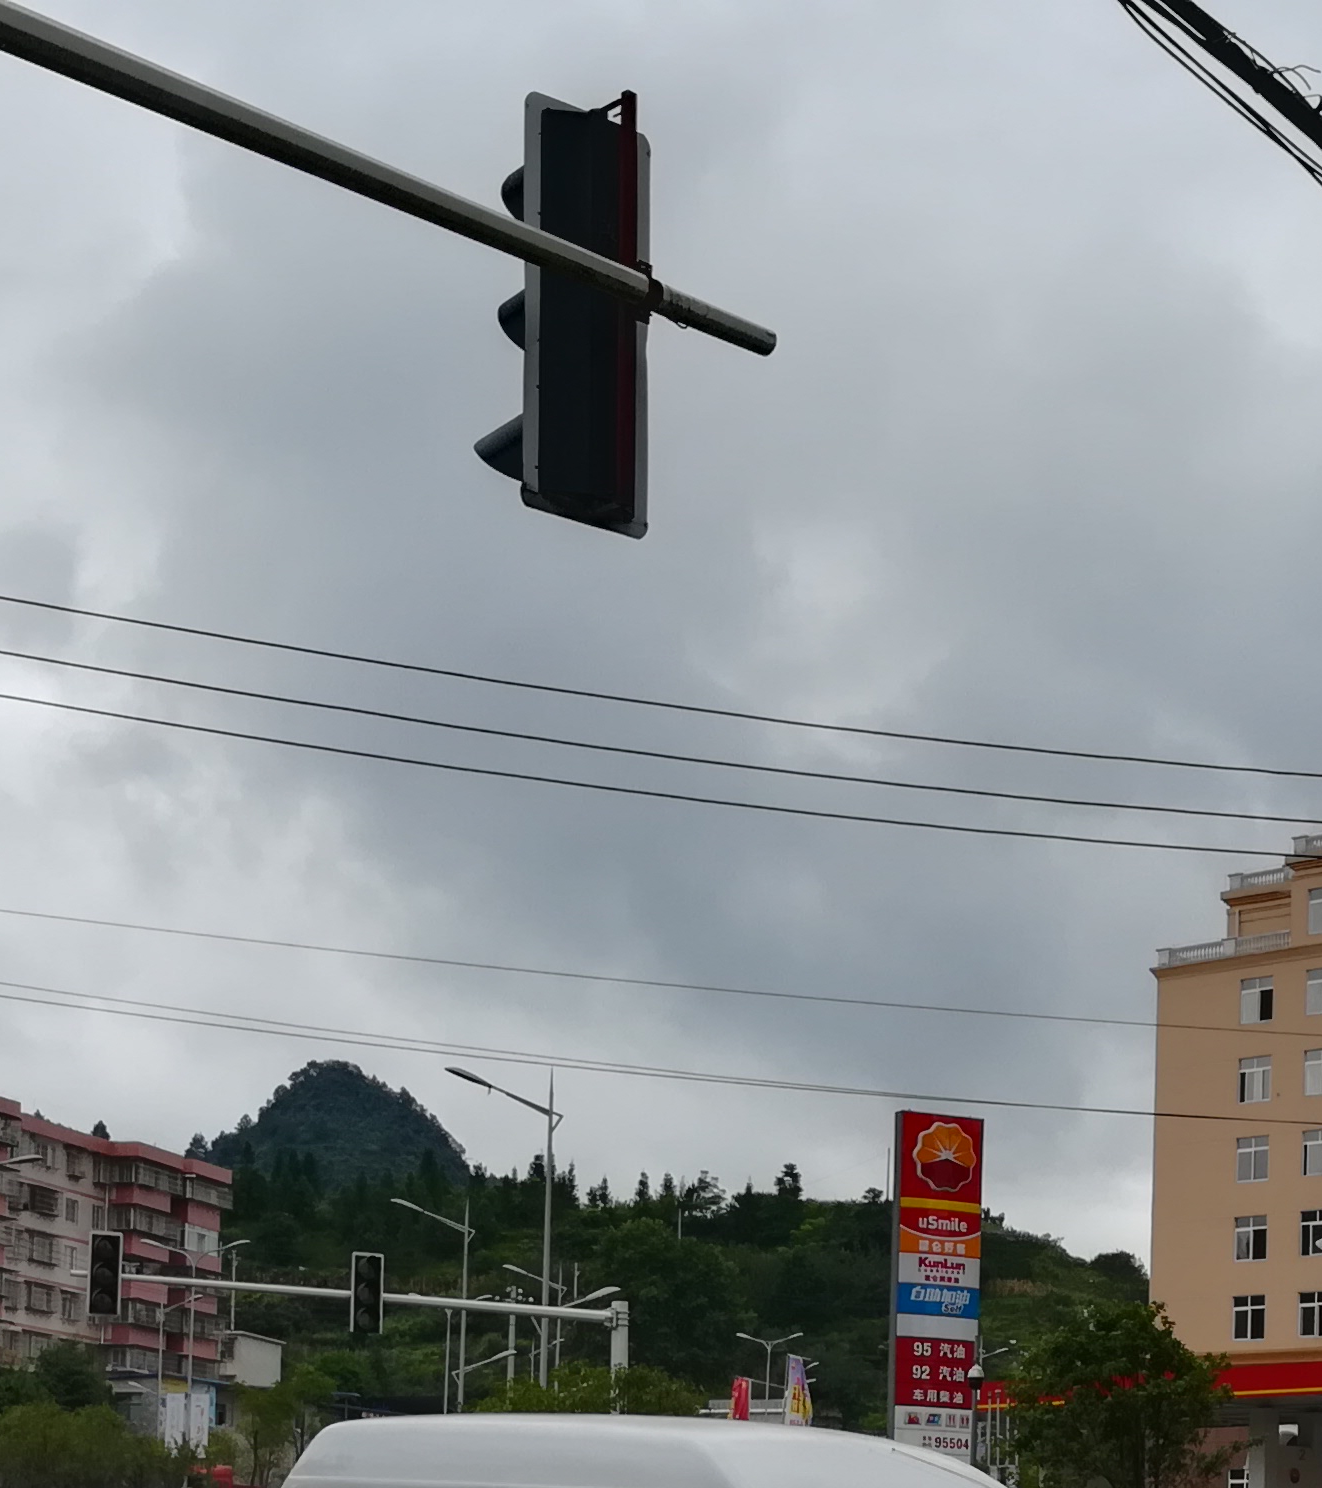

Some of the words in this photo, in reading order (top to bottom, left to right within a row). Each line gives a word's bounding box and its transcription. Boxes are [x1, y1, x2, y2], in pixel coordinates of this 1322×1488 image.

[918, 1216, 968, 1233] uSmile
[918, 1257, 966, 1272] KunLun
[910, 1285, 971, 1305] 自助加油
[913, 1341, 932, 1357] 95
[939, 1342, 966, 1359] 汽油
[912, 1364, 931, 1380] 92
[938, 1366, 965, 1383] 汽油
[912, 1388, 964, 1404] 车用柴油
[934, 1436, 969, 1450] 95504
